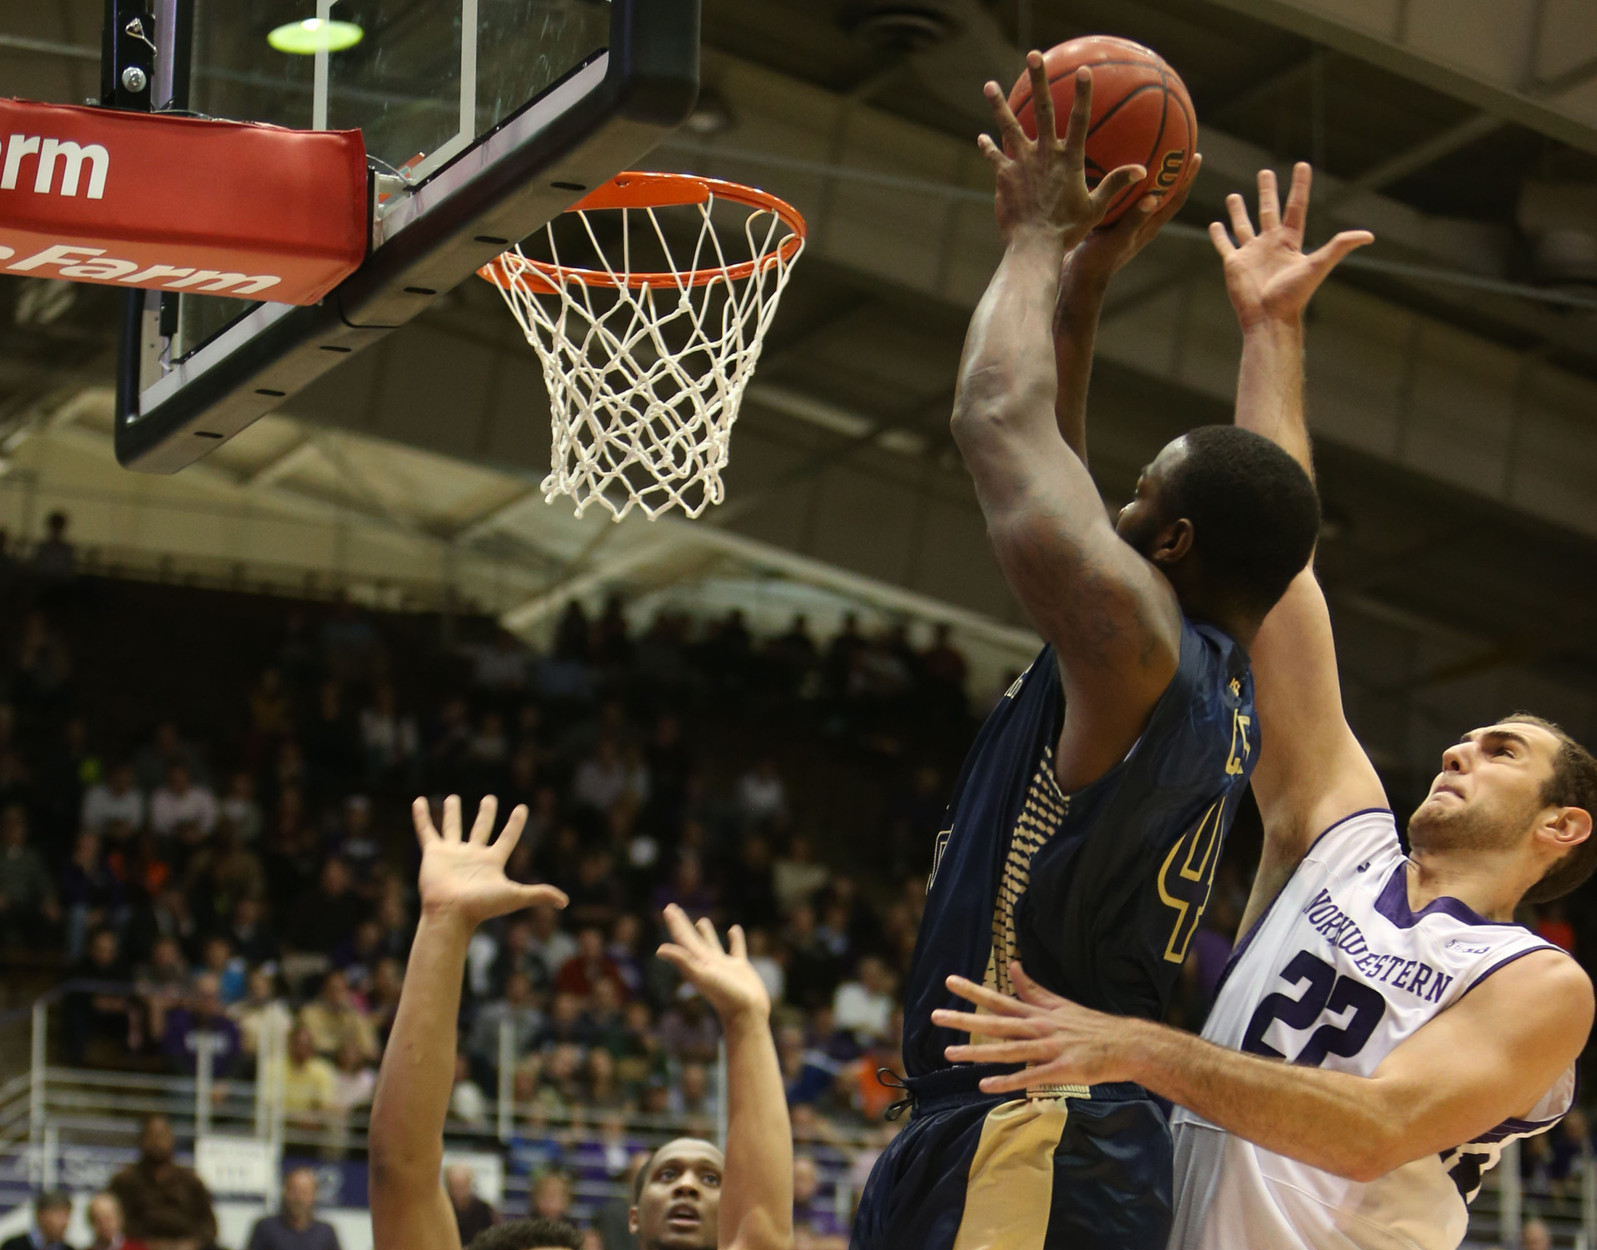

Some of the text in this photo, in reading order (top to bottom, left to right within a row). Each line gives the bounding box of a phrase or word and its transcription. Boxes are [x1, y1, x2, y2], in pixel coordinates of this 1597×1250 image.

[0, 134, 110, 200] rm
[6, 244, 282, 295] Farm
[1302, 888, 1453, 1003] NORHWESTERN
[1241, 949, 1386, 1067] 22
